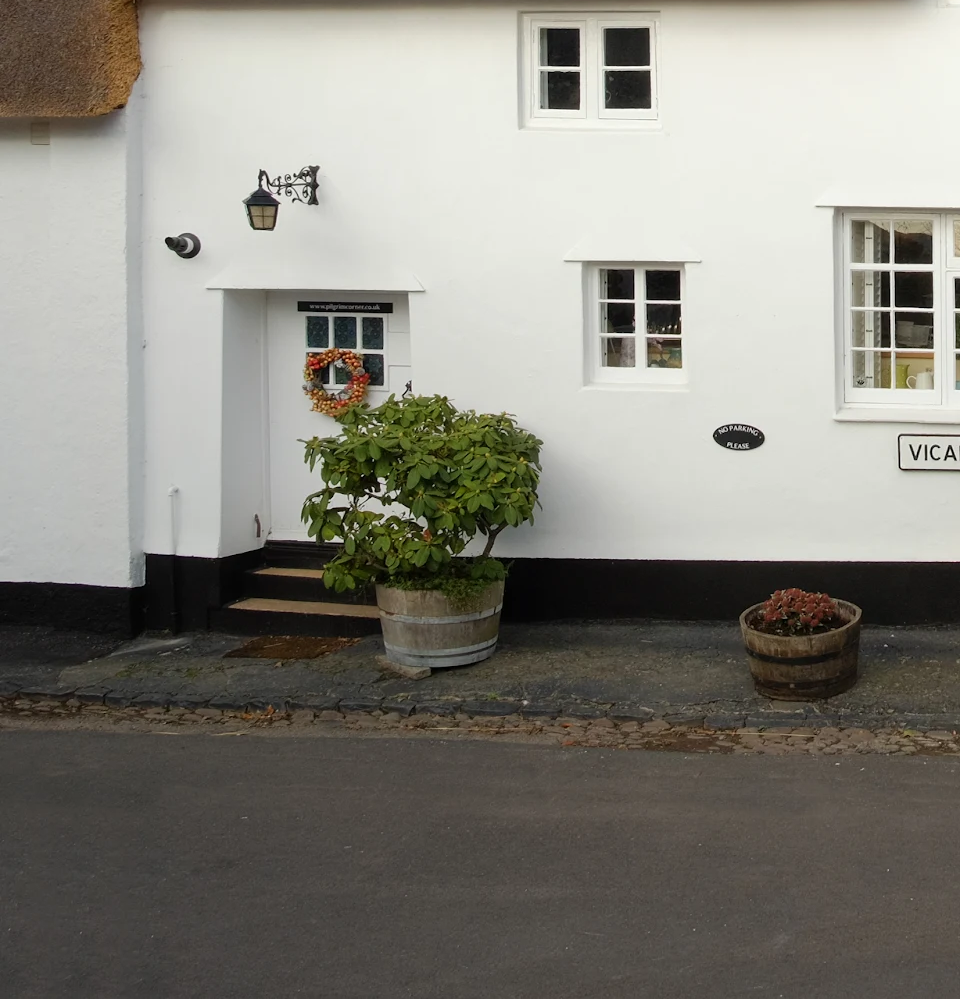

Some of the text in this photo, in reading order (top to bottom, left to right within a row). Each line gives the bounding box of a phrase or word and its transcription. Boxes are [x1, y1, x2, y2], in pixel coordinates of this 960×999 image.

[309, 303, 381, 311] www.pilgrimcorner.co.uk
[718, 425, 759, 436] NO PARKING
